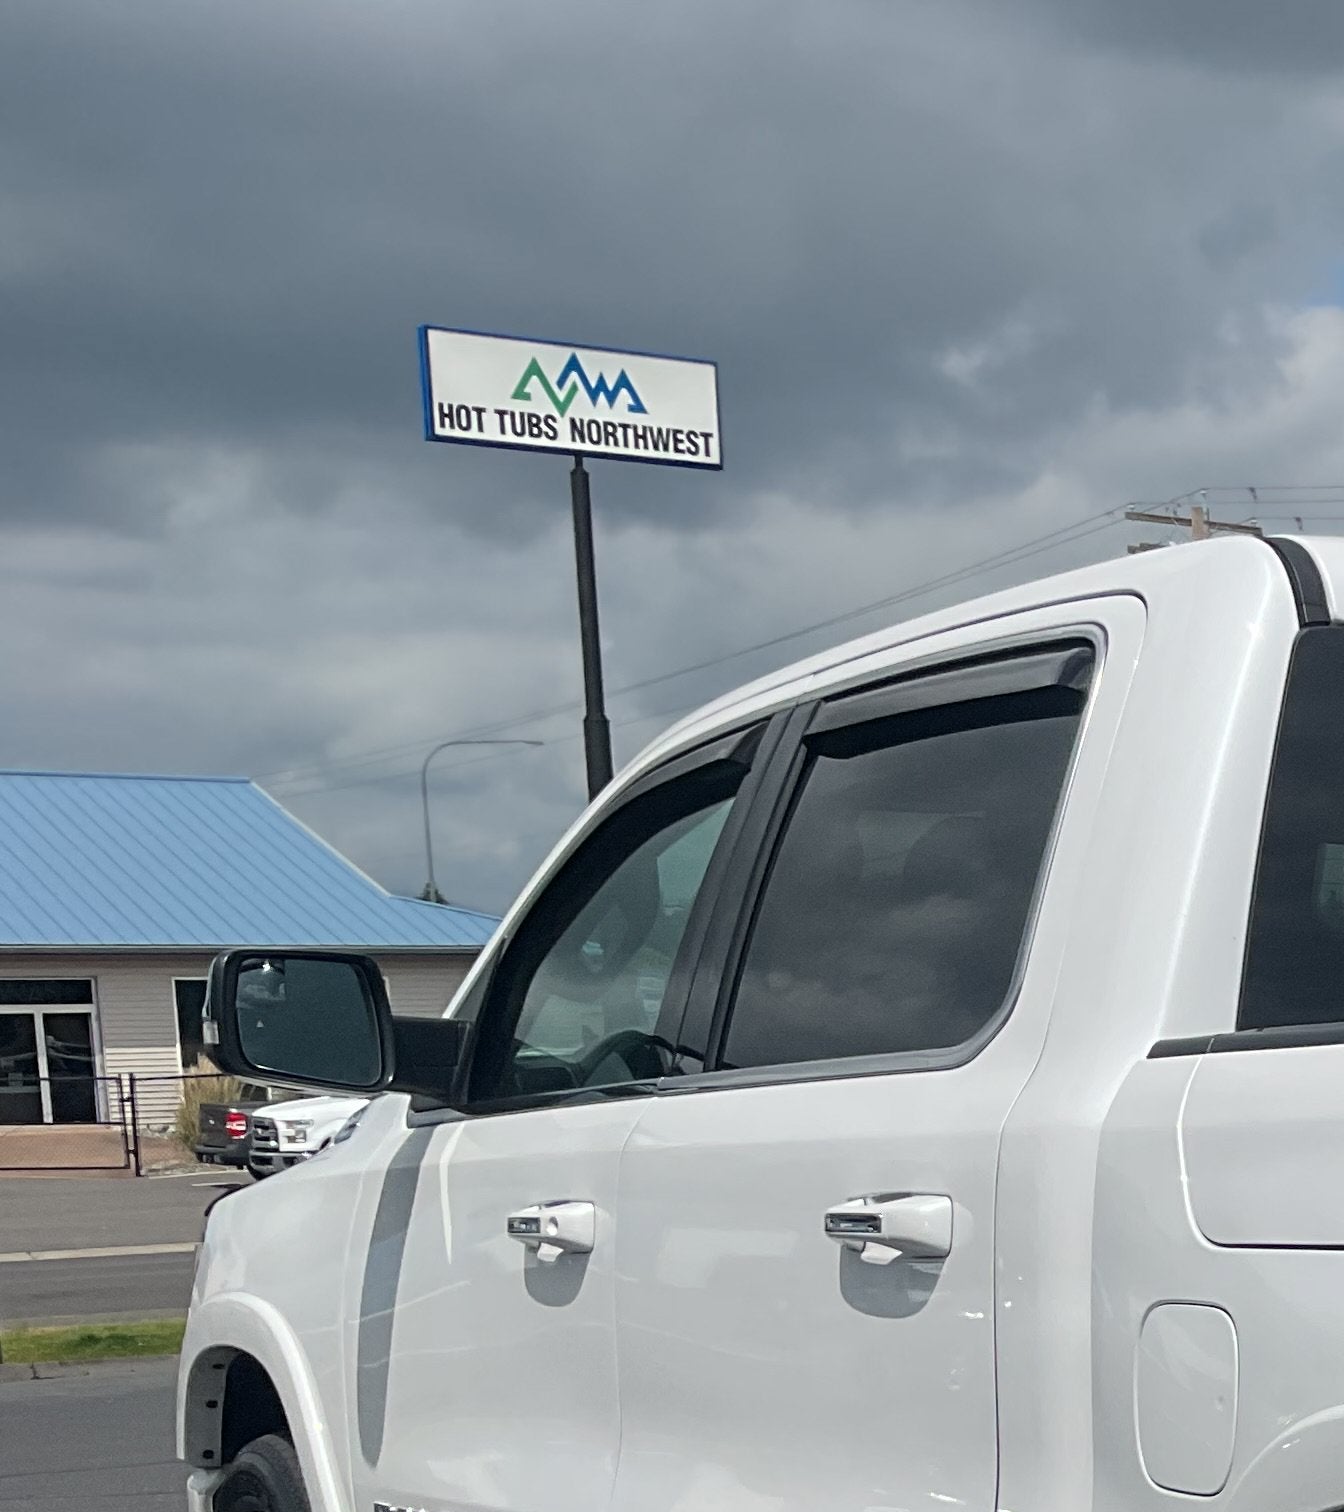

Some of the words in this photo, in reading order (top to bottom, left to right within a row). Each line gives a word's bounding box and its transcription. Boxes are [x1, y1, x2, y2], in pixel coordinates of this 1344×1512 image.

[437, 402, 486, 433] HOT
[494, 408, 558, 441] TUBS
[569, 417, 714, 458] NORTHWEST
